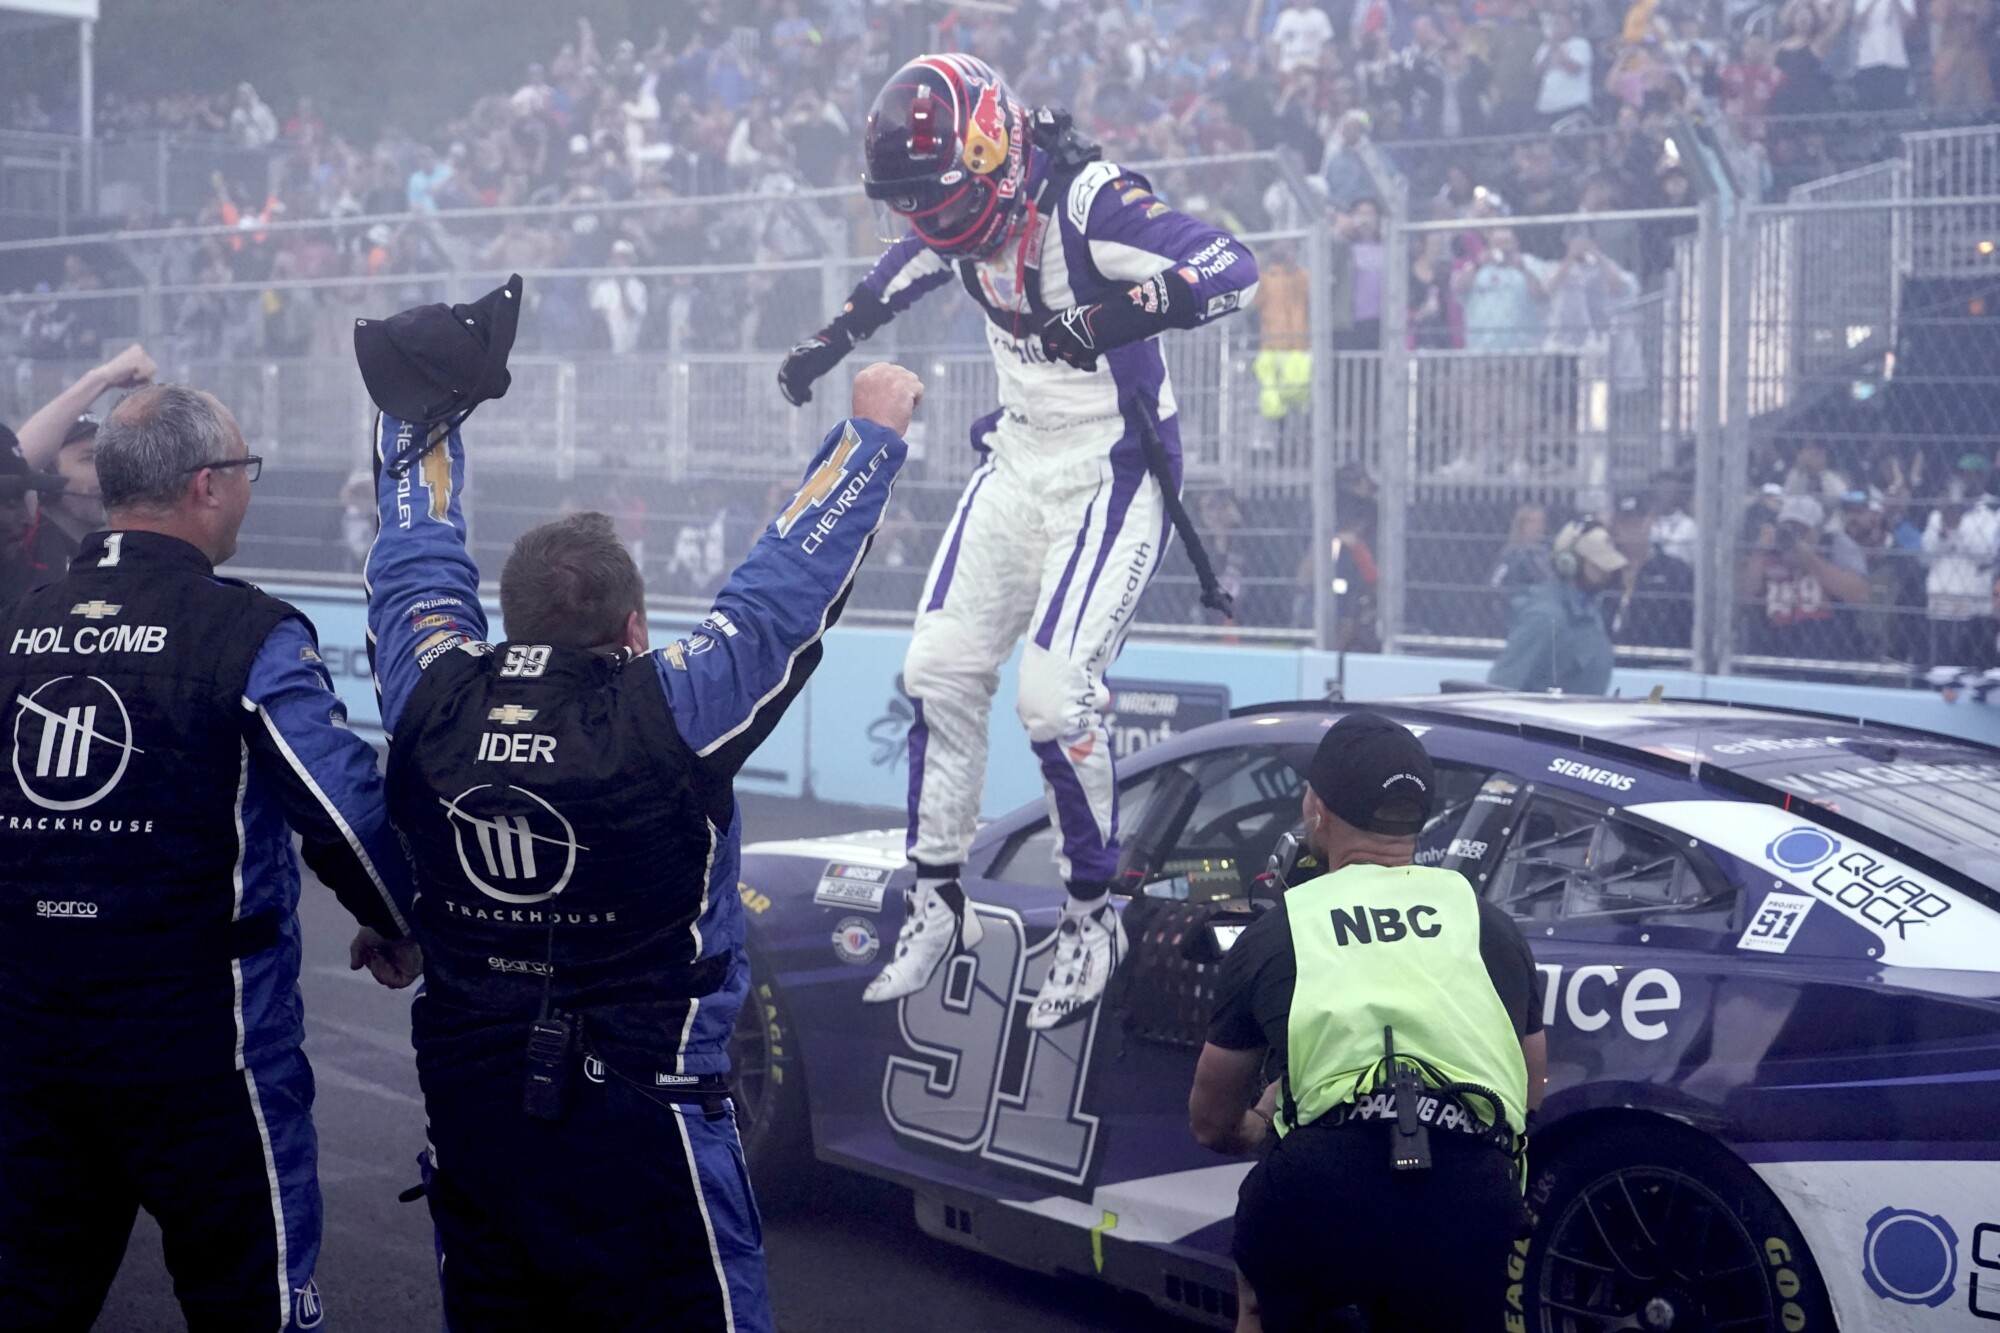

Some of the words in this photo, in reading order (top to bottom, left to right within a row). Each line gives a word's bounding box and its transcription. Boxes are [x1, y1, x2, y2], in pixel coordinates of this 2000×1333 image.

[998, 146, 1022, 198] Red
[1199, 249, 1239, 280] health
[800, 444, 890, 555] CHEVROLET
[97, 533, 123, 568] 1
[1110, 542, 1151, 622] health
[9, 624, 168, 655] HOLCOMB
[418, 636, 458, 671] NASCAR
[500, 644, 553, 677] 99
[477, 732, 557, 763] IDER
[1547, 757, 1636, 792] SIEMENS
[1838, 852, 1951, 918] QUAD
[37, 900, 98, 918] sparco
[445, 900, 616, 924] TRACKHOUSE
[1767, 901, 1805, 910] PROJECT
[1812, 866, 1927, 940] LOCK
[1330, 904, 1443, 947] NBC
[1750, 909, 1799, 940] 91
[882, 901, 1099, 1185] 91
